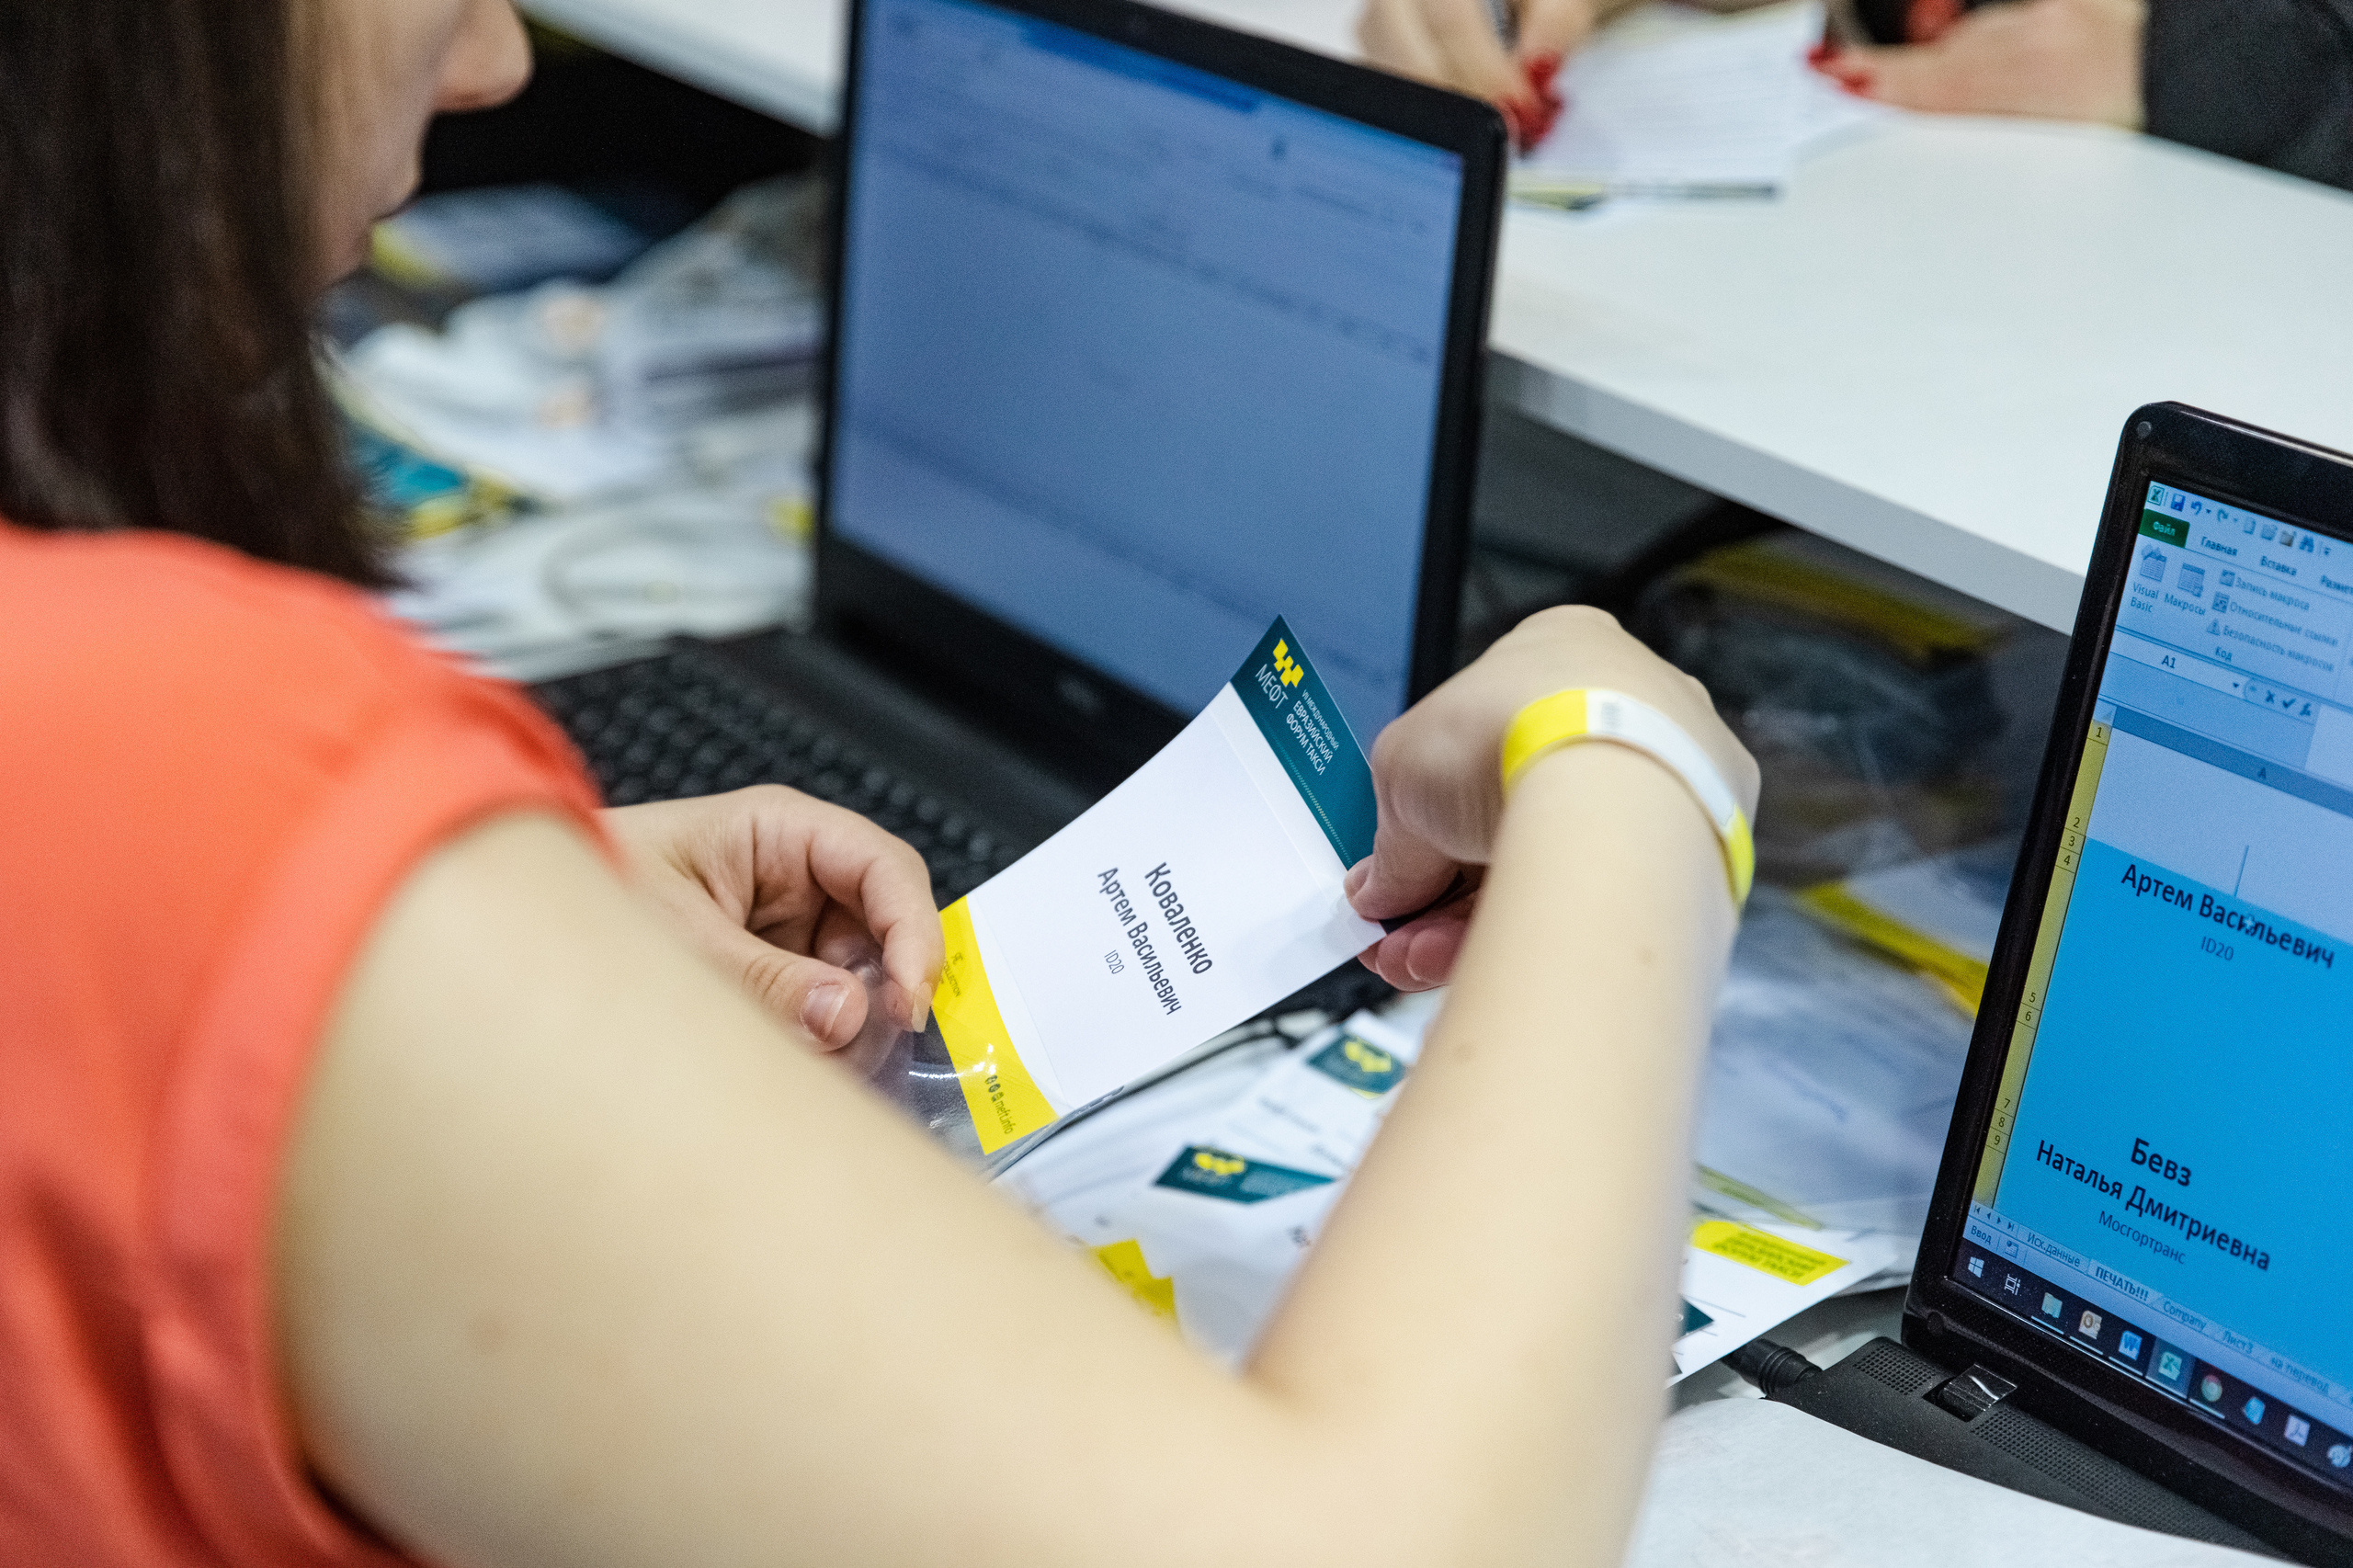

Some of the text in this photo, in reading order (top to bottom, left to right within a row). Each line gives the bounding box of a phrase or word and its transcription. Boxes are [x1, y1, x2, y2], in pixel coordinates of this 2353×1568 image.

[2153, 520, 2176, 536] Файл
[2200, 536, 2238, 556] Главная
[2260, 555, 2297, 576] Вставка
[2132, 582, 2159, 599] Visual
[2235, 576, 2310, 611] Запись макроса
[2130, 597, 2154, 613] Basic
[2164, 593, 2206, 616] Макросы
[2229, 601, 2338, 646] Относительные ссылки
[2215, 646, 2233, 662] Код
[2222, 625, 2336, 672] Безопасность макросов
[2161, 654, 2176, 669] A1
[1256, 664, 1289, 709] МЕФТ
[1292, 699, 1333, 764] ЕВРАЗИЙСКИЙ
[2096, 726, 2104, 738] 1
[1286, 713, 1326, 776] ФОРУМ ТАКСИ
[2073, 816, 2081, 829] 2
[2068, 835, 2076, 847] 3
[2063, 854, 2072, 866] 4
[1143, 861, 1213, 974] Коваленко
[2120, 863, 2336, 969] Артем Васильевич
[1097, 867, 1182, 1016] Артем Васильевич
[2200, 936, 2234, 961] ID20
[1104, 949, 1125, 974] ID20
[2029, 992, 2037, 1004] 5
[2024, 1011, 2032, 1023] 6
[2004, 1097, 2011, 1108] 7
[995, 1100, 1016, 1134] meft.info
[1998, 1117, 2006, 1128] 8
[1994, 1134, 2001, 1146] 9
[2131, 1137, 2193, 1187] Бевз
[2036, 1140, 2272, 1272] Наталья Дмитриевна
[1970, 1225, 1993, 1244] Ввод
[2098, 1210, 2188, 1266] Мосгортранс
[2028, 1232, 2150, 1301] Исх.данные ПЕЧАТЬ!!!
[2163, 1301, 2207, 1331] Company
